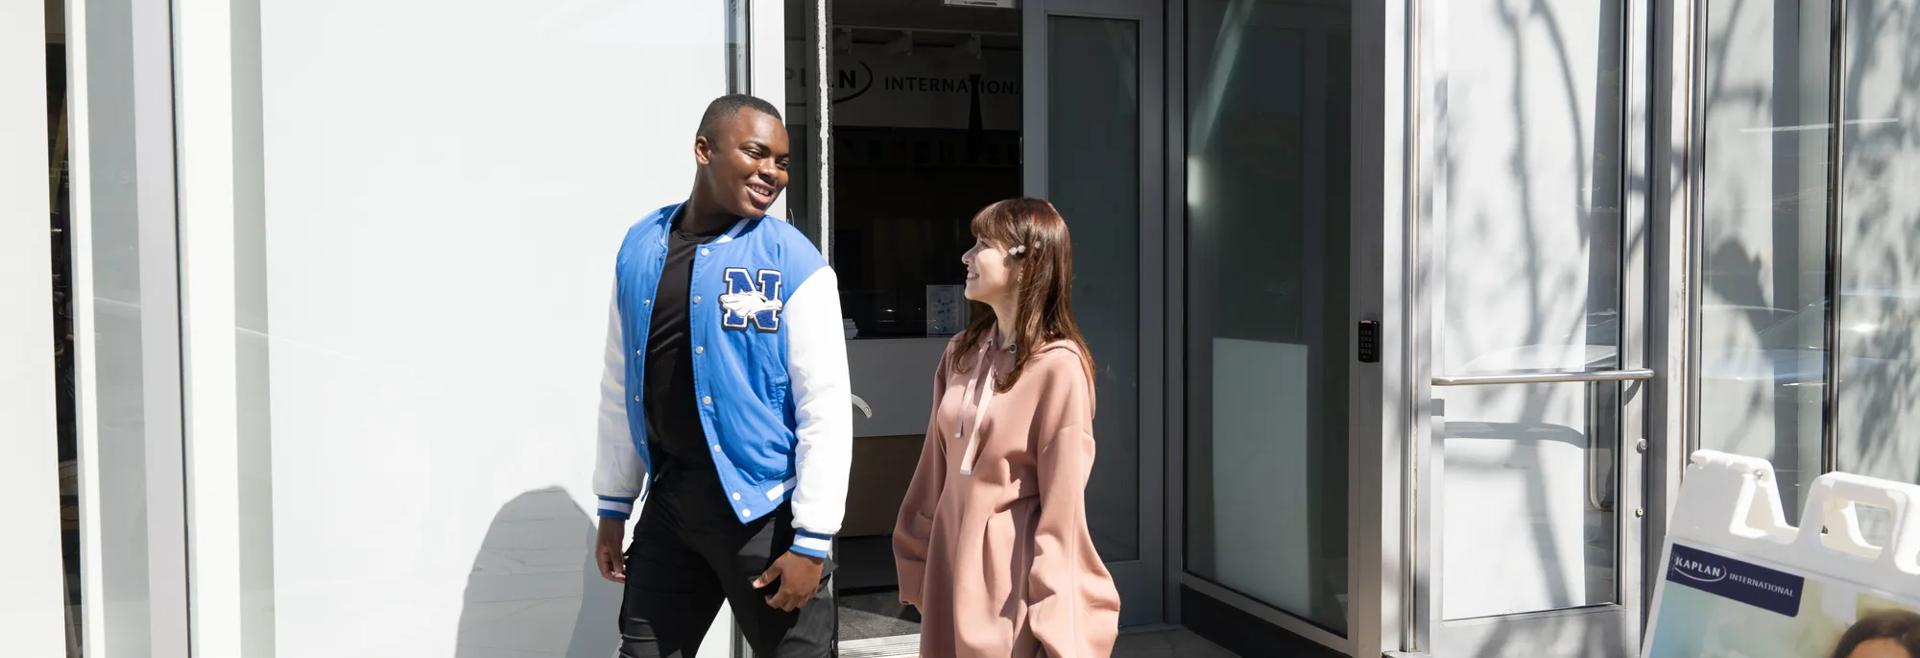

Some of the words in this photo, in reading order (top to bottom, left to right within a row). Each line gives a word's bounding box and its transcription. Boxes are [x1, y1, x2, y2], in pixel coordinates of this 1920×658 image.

[722, 267, 782, 333] N
[1675, 556, 1721, 577] KAPLAN
[1729, 572, 1793, 597] INTERNATIONAL
